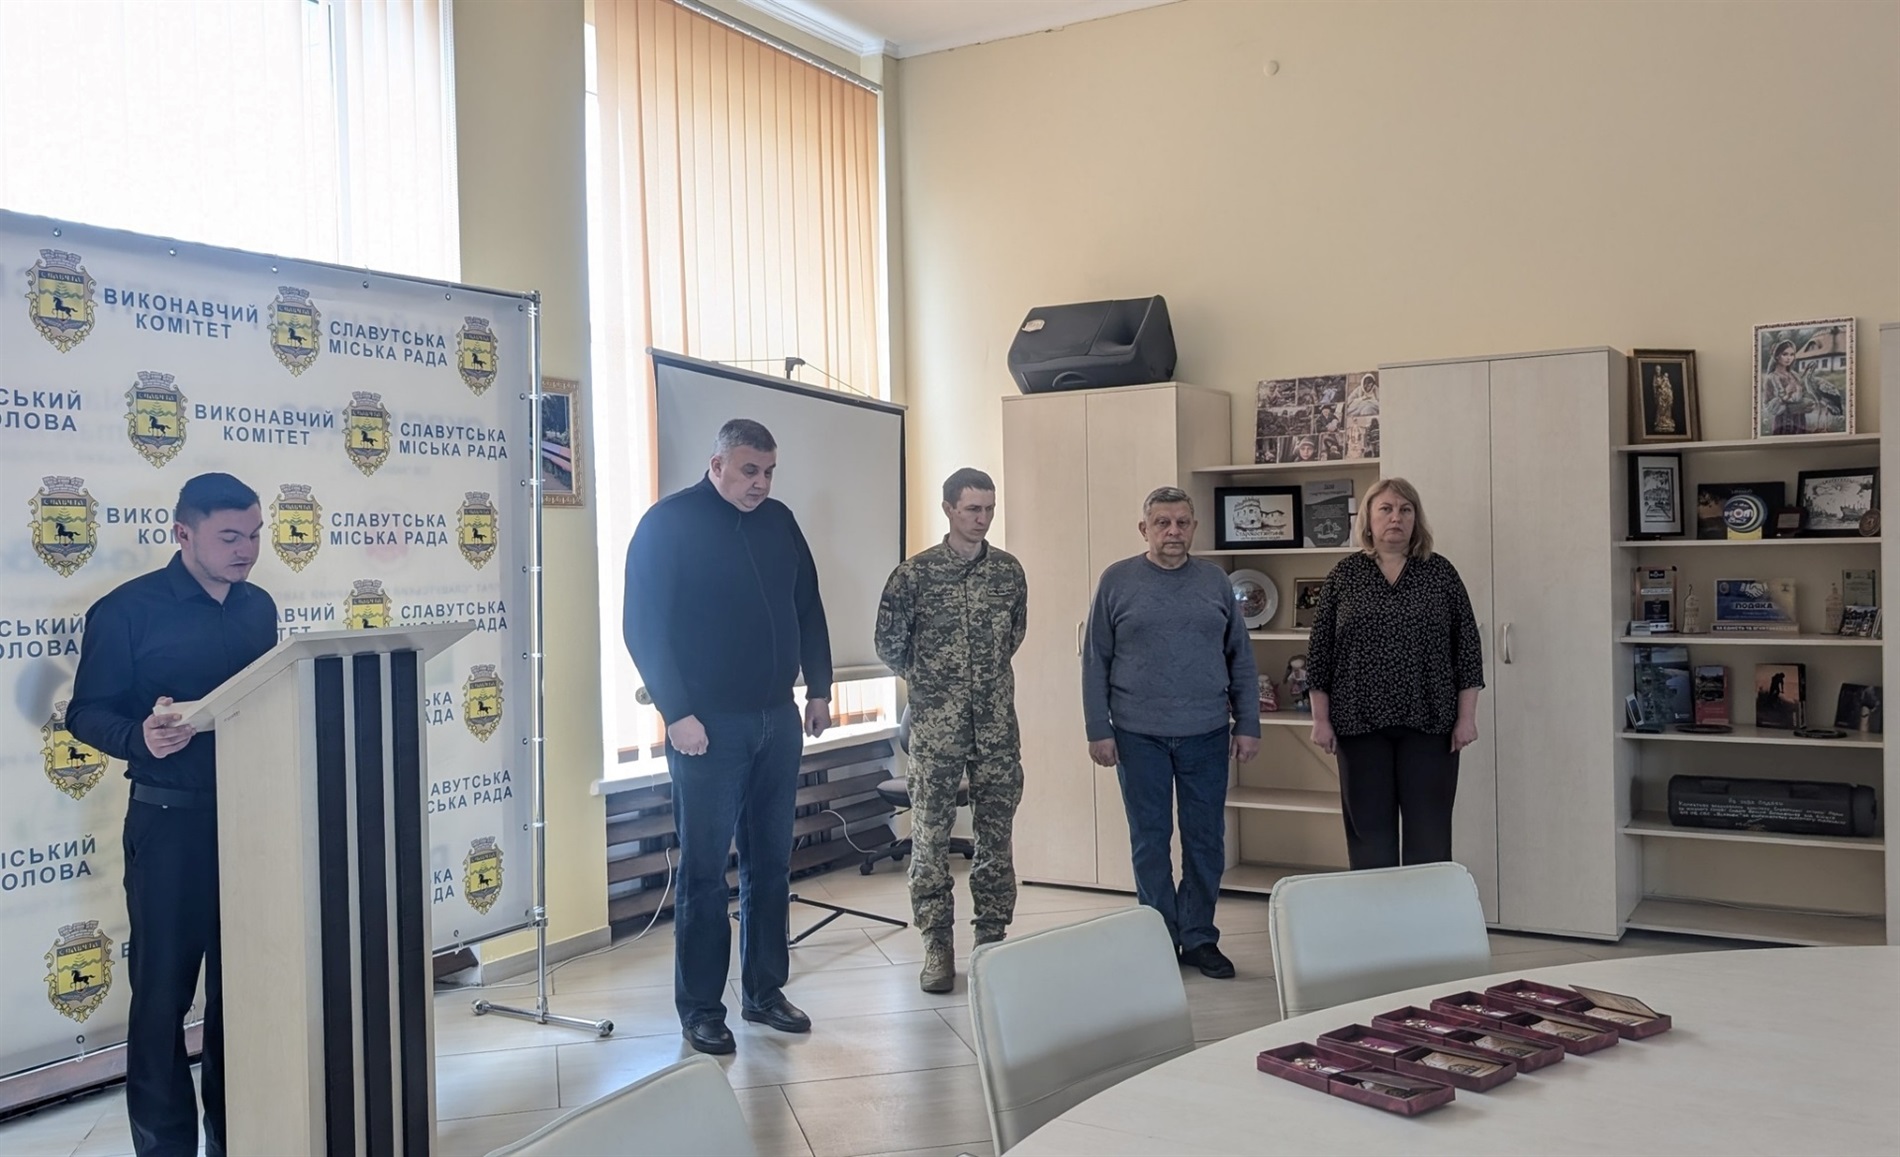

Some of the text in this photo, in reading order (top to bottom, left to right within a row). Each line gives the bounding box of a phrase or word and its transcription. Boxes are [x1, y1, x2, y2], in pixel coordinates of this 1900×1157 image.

[104, 287, 258, 324] ВИКОНАВЧИЙ
[136, 312, 232, 339] КОМІТЕТ
[330, 320, 446, 349] СЛАВУТСЬКА
[329, 338, 448, 368] МІСЬКА РАДА
[195, 403, 334, 429] ВИКОНАВЧИЙ
[223, 425, 310, 446] КОМІТЕТ
[400, 422, 506, 443] СЛАВУТСЬКА
[399, 439, 508, 461] МІСЬКА РАДА
[331, 512, 447, 528] СЛАВУТСЬКА
[330, 530, 448, 547] МІСЬКА РАДА
[401, 600, 506, 619] СЛАВУТСЬКА
[430, 769, 512, 797] АВУТСЬКА
[473, 786, 513, 805] РАДА
[1, 833, 96, 869] ІСЬКИЙ
[1, 861, 92, 891] ОЛОВА
